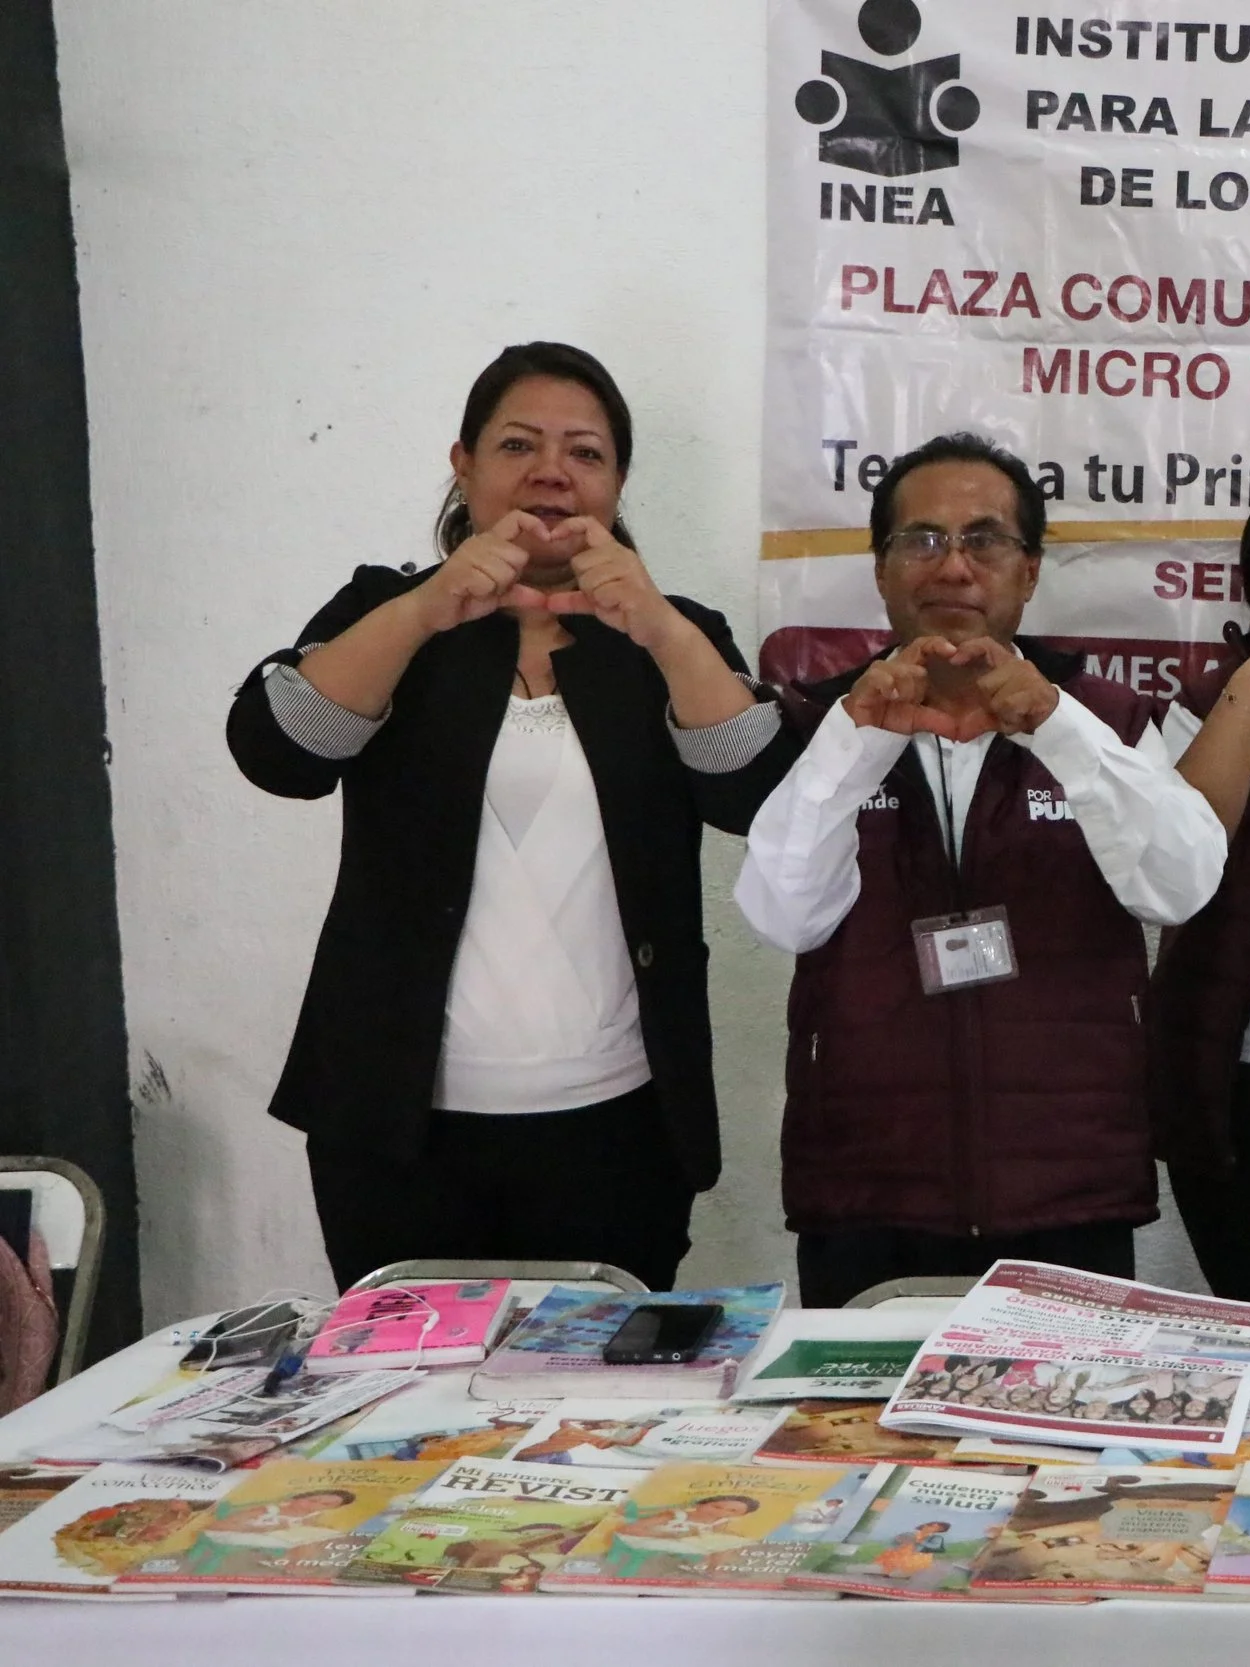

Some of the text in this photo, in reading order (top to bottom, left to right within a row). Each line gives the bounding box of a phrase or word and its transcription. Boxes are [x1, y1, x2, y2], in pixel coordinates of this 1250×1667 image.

[1026, 90, 1178, 136] PARA
[1081, 166, 1153, 207] DE
[820, 183, 955, 226] INEA
[841, 265, 1041, 319] PLAZA
[1022, 348, 1230, 400] MICRO
[1084, 457, 1144, 503] tu
[859, 792, 900, 811] nde
[1027, 789, 1052, 801] POR
[1005, 1296, 1068, 1314] INICIO
[1040, 1292, 1105, 1309] FUTURO
[1099, 1315, 1154, 1325] SOLO
[1071, 1356, 1120, 1365] UNEN
[455, 1467, 572, 1485] Mi primera
[441, 1474, 629, 1502] REVIST
[909, 1480, 1015, 1496] Cuidemos
[916, 1487, 999, 1501] nuestra
[909, 1494, 996, 1511] salud
